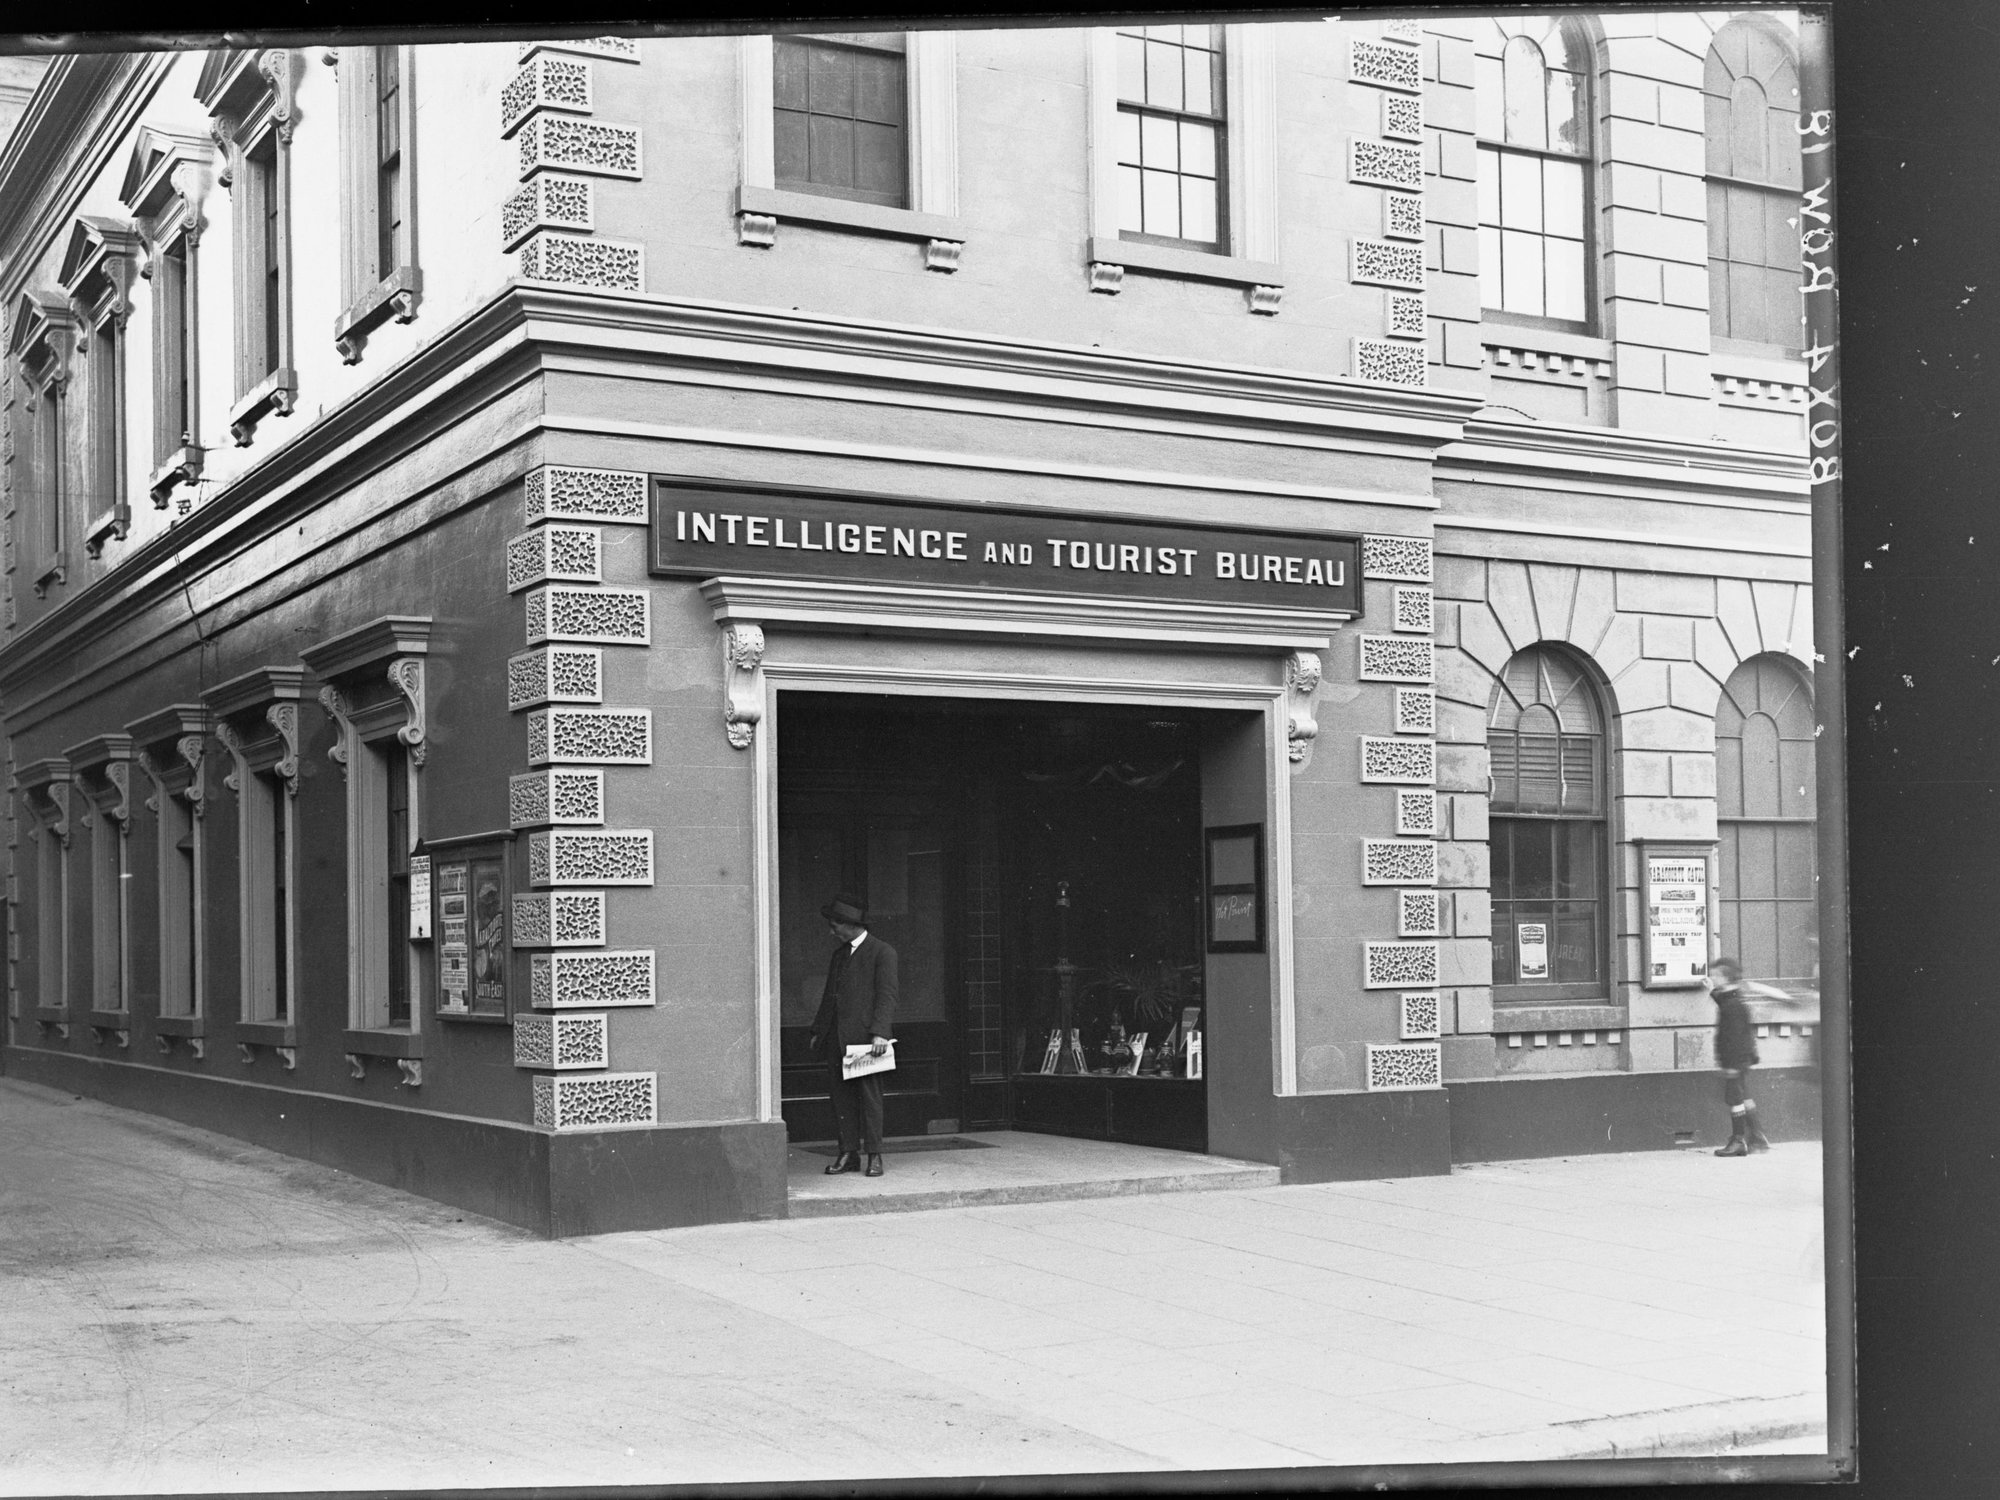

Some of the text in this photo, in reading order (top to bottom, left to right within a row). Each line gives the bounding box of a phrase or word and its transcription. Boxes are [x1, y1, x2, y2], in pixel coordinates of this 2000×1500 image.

[677, 510, 1345, 587] INTELLIGENCE AND TOURIST BUREAU
